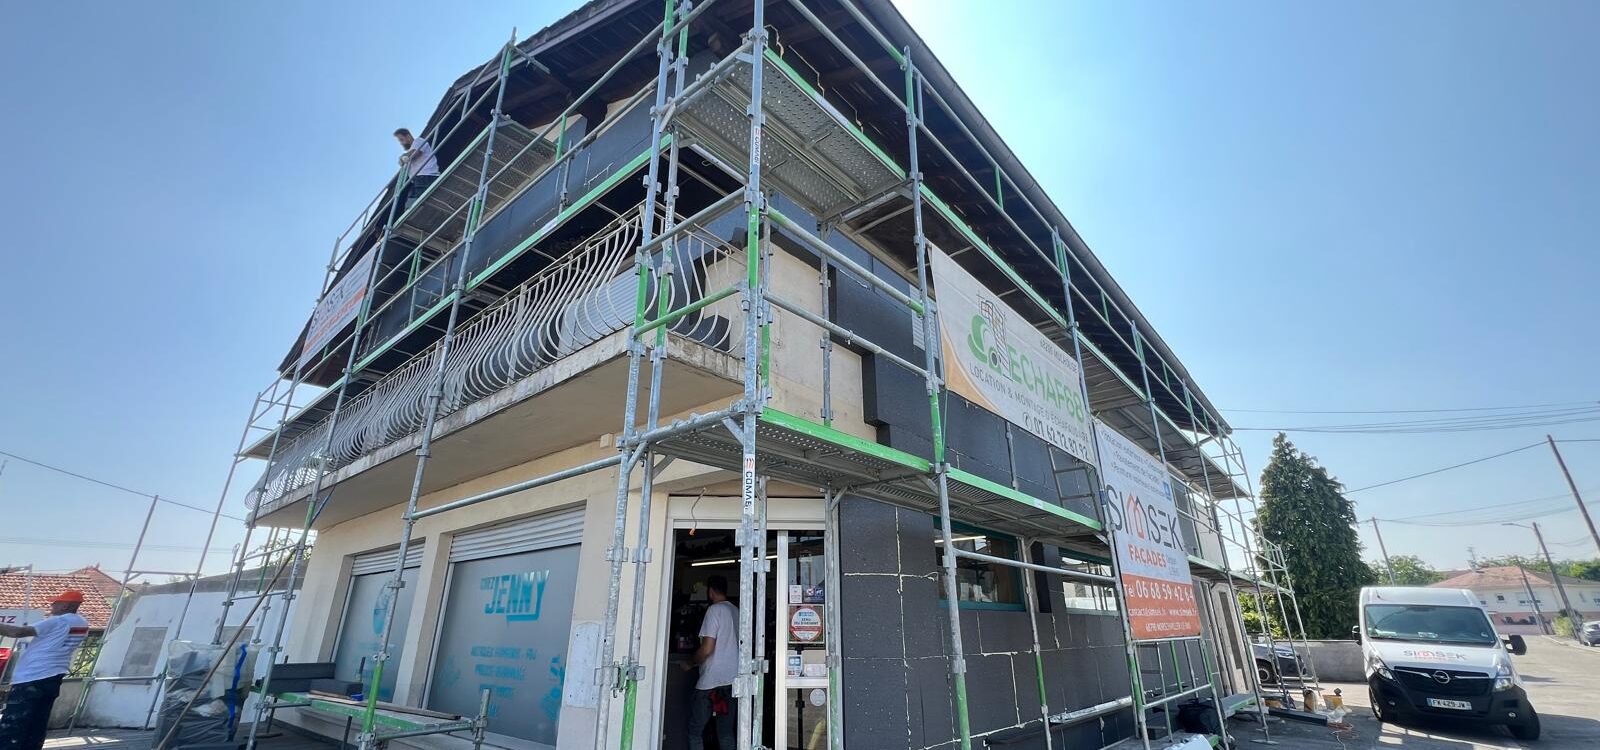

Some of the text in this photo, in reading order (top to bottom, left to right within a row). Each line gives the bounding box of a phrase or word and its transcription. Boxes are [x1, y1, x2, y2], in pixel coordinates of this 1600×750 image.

[969, 362, 1005, 394] LOCATION
[1106, 484, 1184, 552] SIMSEK
[485, 569, 550, 622] JENNY
[1136, 580, 1149, 598] 06
[1150, 582, 1161, 600] 68
[1162, 583, 1172, 600] 59
[1174, 586, 1184, 601] 42
[1403, 650, 1467, 660] SIMSEK
